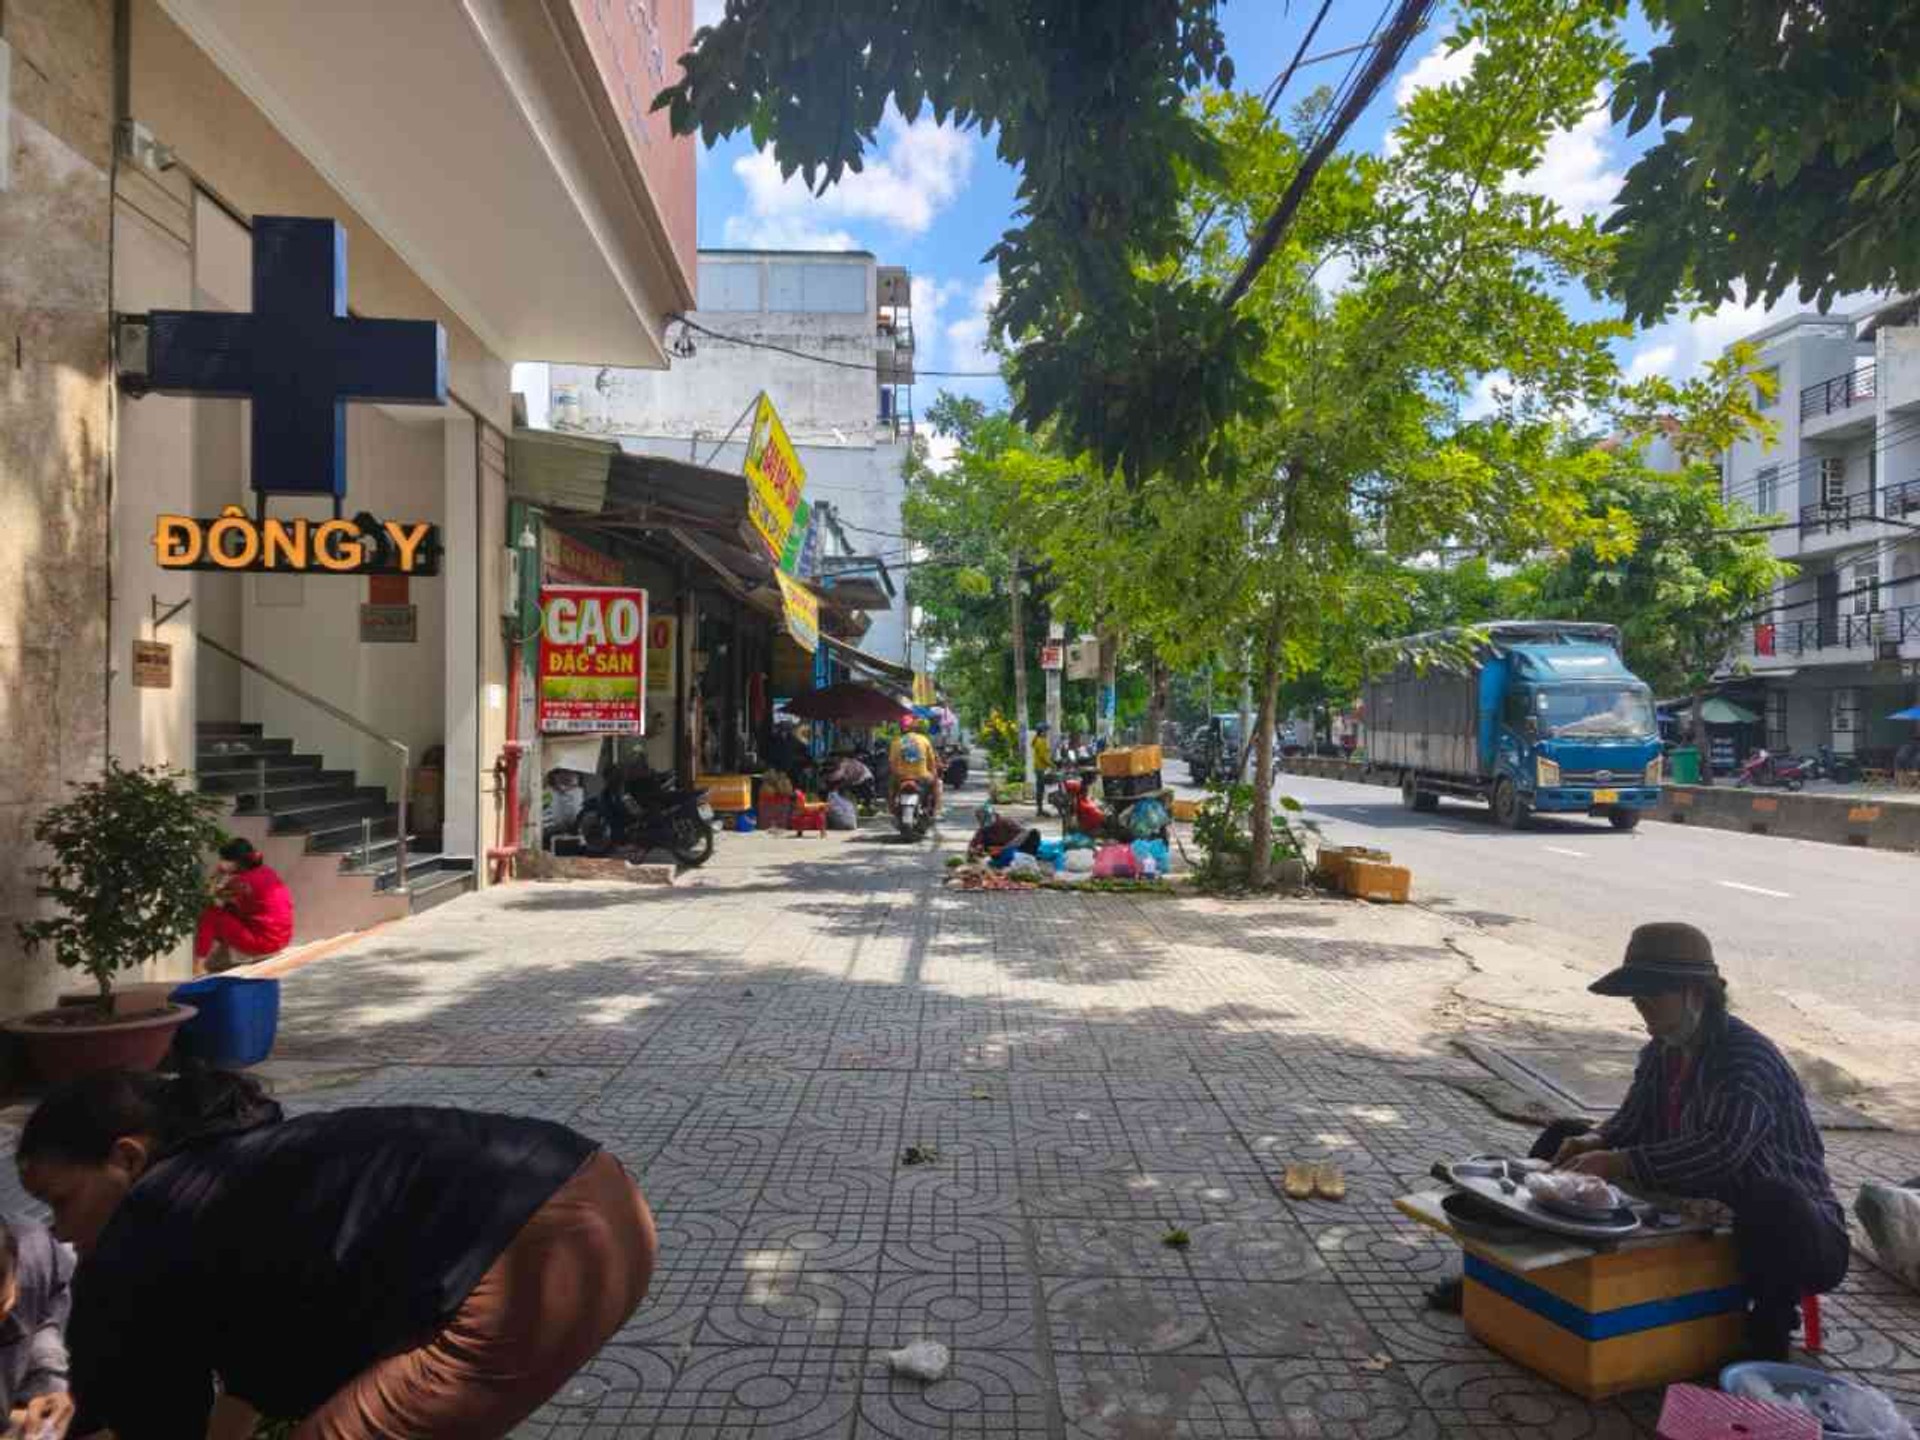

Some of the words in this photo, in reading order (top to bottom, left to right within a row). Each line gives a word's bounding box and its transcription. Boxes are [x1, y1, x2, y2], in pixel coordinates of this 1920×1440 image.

[152, 503, 362, 570] ĐÔNG
[384, 519, 431, 572] Y
[545, 598, 640, 655] GẠO
[549, 648, 590, 675] ĐẶC
[595, 646, 633, 673] SẢN
